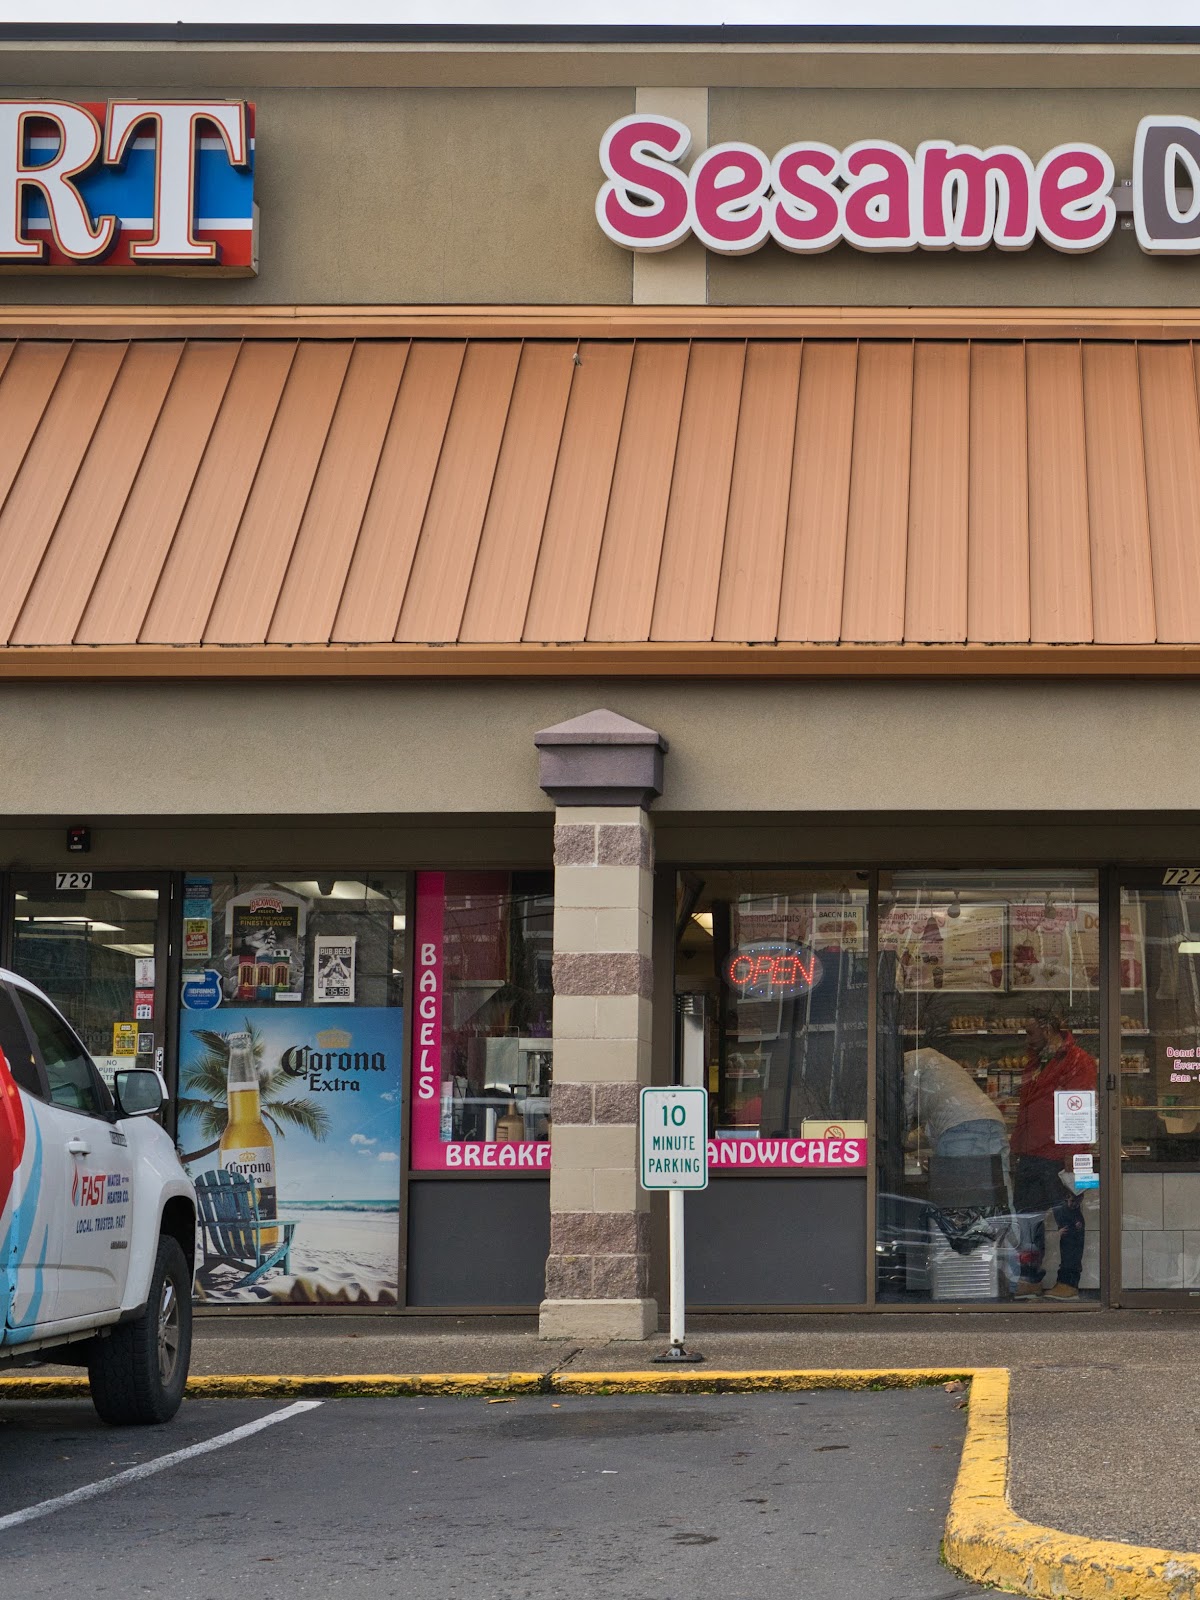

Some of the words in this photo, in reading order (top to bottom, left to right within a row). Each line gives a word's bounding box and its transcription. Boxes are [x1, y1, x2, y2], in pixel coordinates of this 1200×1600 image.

[0, 98, 250, 262] RT
[597, 114, 1117, 254] Sesame
[58, 873, 91, 889] 729
[187, 939, 207, 947] Card
[730, 955, 816, 985] OPEN
[418, 943, 437, 1099] BAGELS
[1166, 1046, 1195, 1058] Donut
[281, 1045, 387, 1081] Corona
[309, 1073, 361, 1092] Extra
[1170, 1073, 1191, 1082] 5am
[662, 1105, 686, 1127] 10
[652, 1135, 696, 1151] MINUTE
[446, 1144, 551, 1167] BREAKF
[707, 1141, 860, 1164] ANDWICHES
[648, 1158, 700, 1173] PARKING
[81, 1175, 107, 1207] FAST
[107, 1174, 121, 1187] WATER
[76, 1219, 94, 1234] LOCAL.
[115, 1215, 126, 1229] FAST
